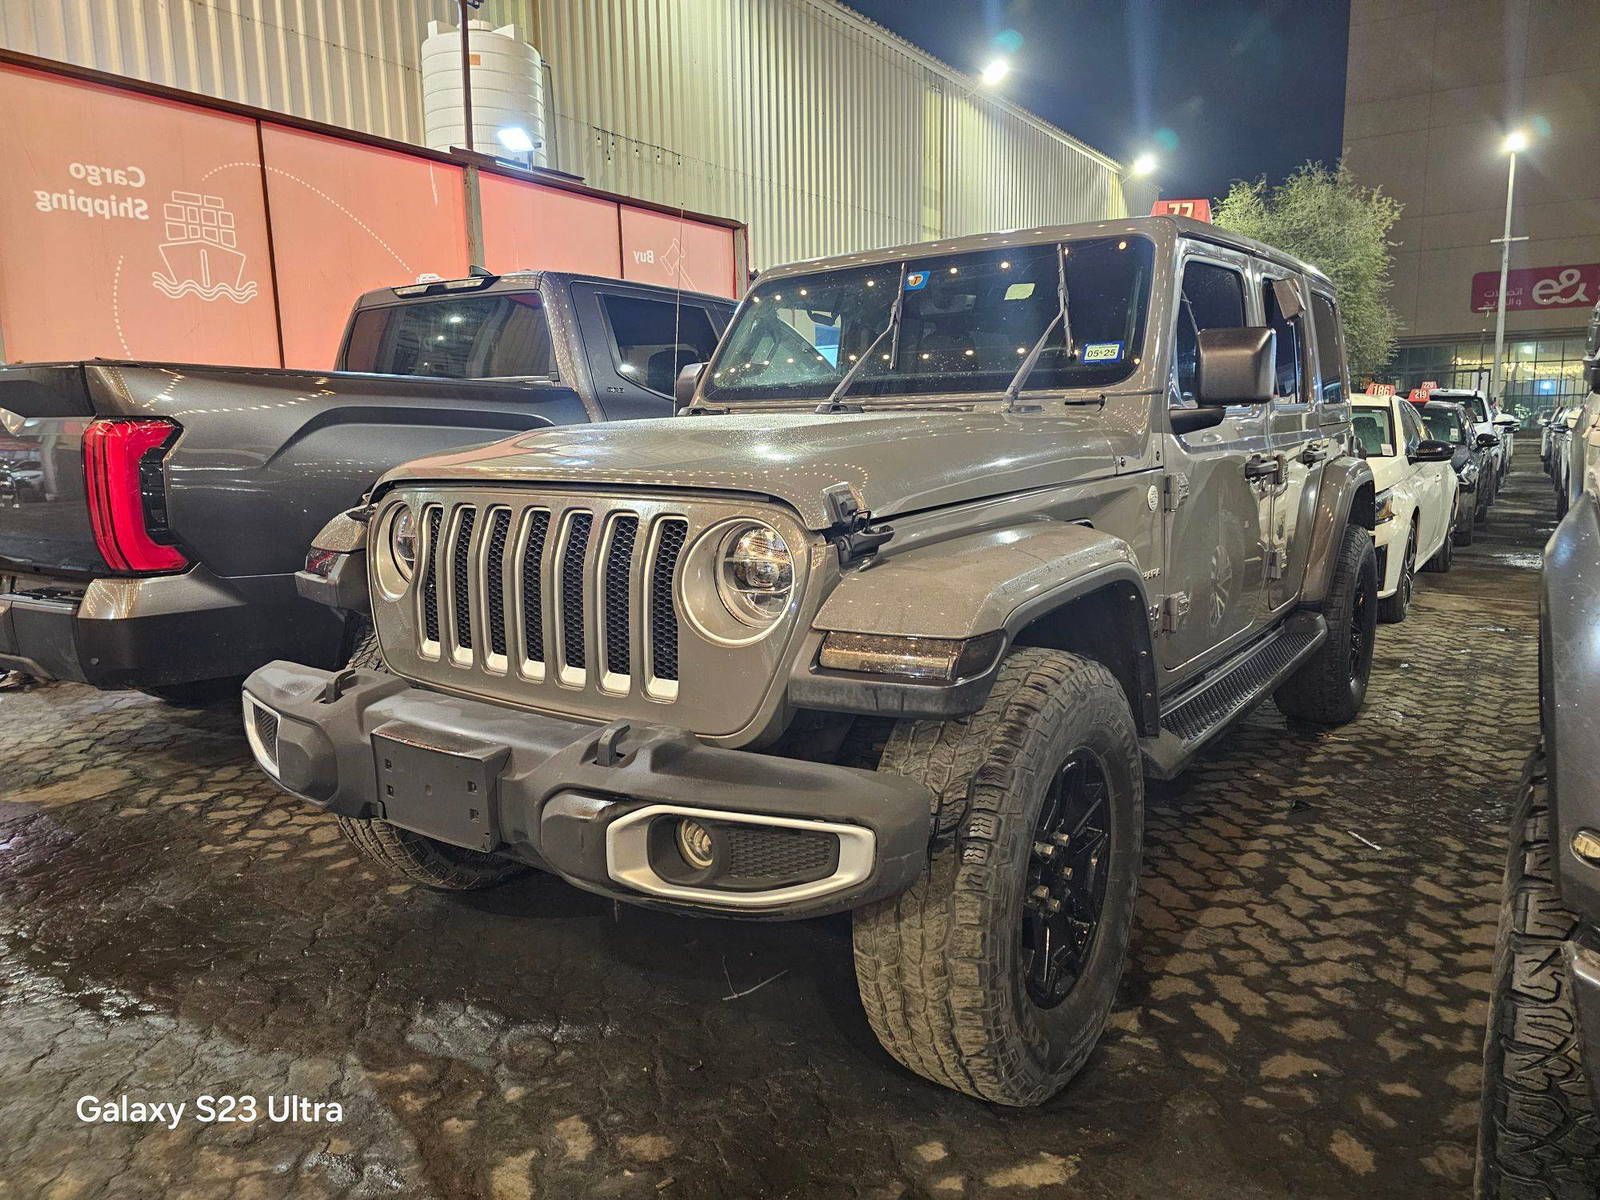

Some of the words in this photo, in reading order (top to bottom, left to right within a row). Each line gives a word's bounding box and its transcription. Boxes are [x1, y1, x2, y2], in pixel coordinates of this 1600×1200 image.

[1168, 202, 1194, 217] 77
[1373, 384, 1391, 396] 186
[1414, 390, 1428, 399] 219
